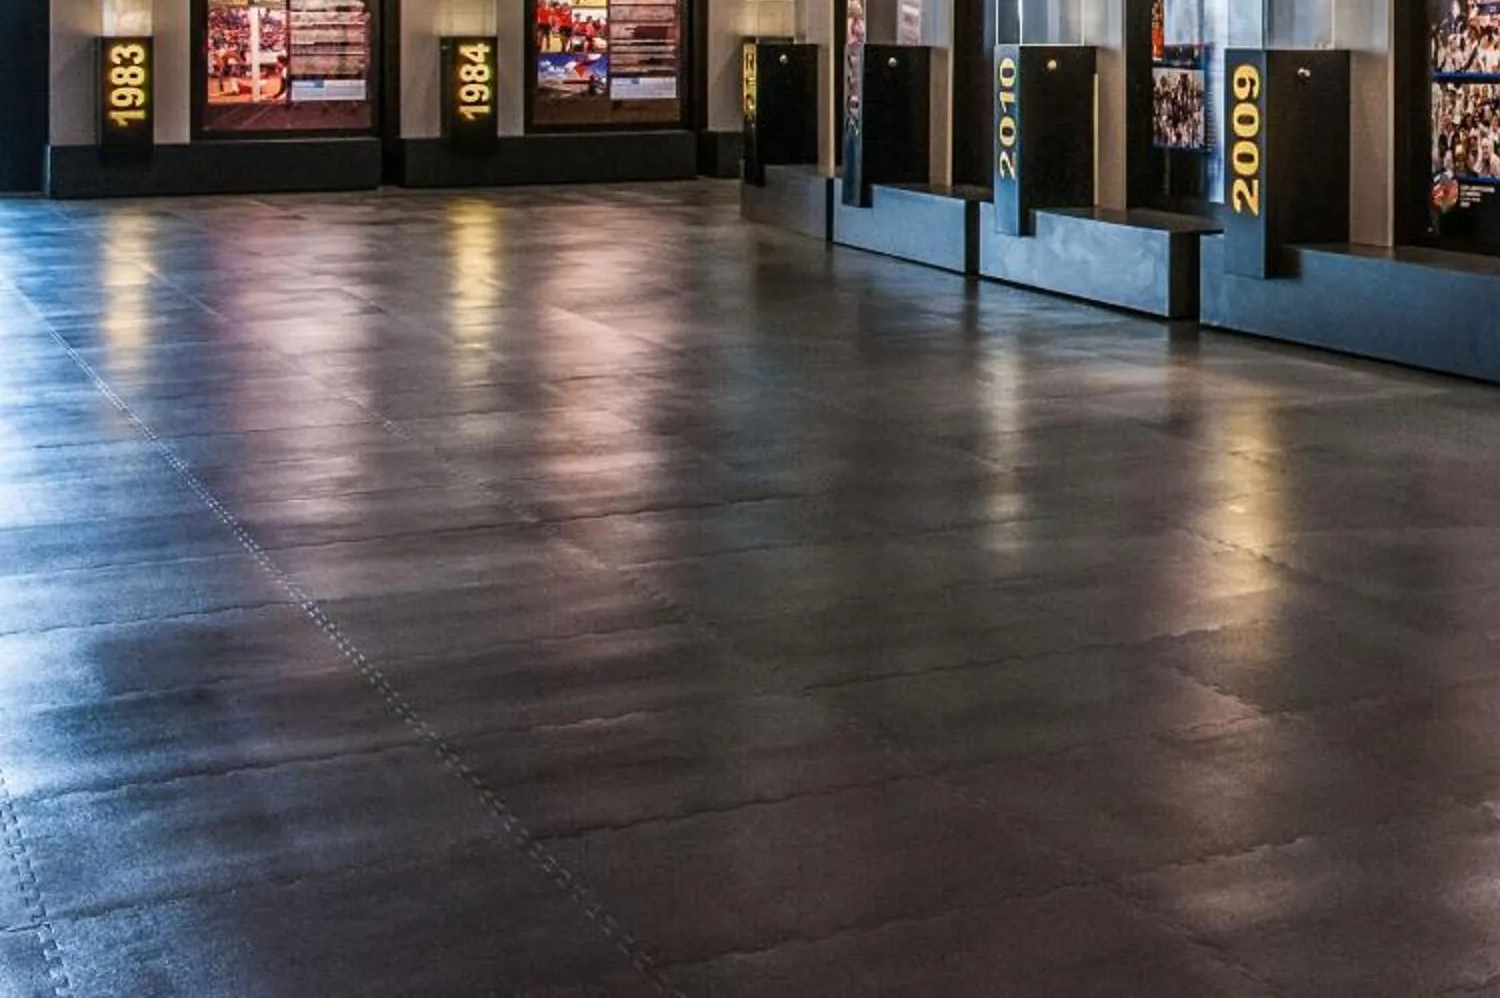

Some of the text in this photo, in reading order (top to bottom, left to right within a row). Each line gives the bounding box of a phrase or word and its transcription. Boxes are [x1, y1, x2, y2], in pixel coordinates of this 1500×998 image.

[109, 43, 147, 126] 1983
[457, 42, 492, 120] 1984
[998, 56, 1016, 180] 2010
[1232, 63, 1260, 217] 2009
